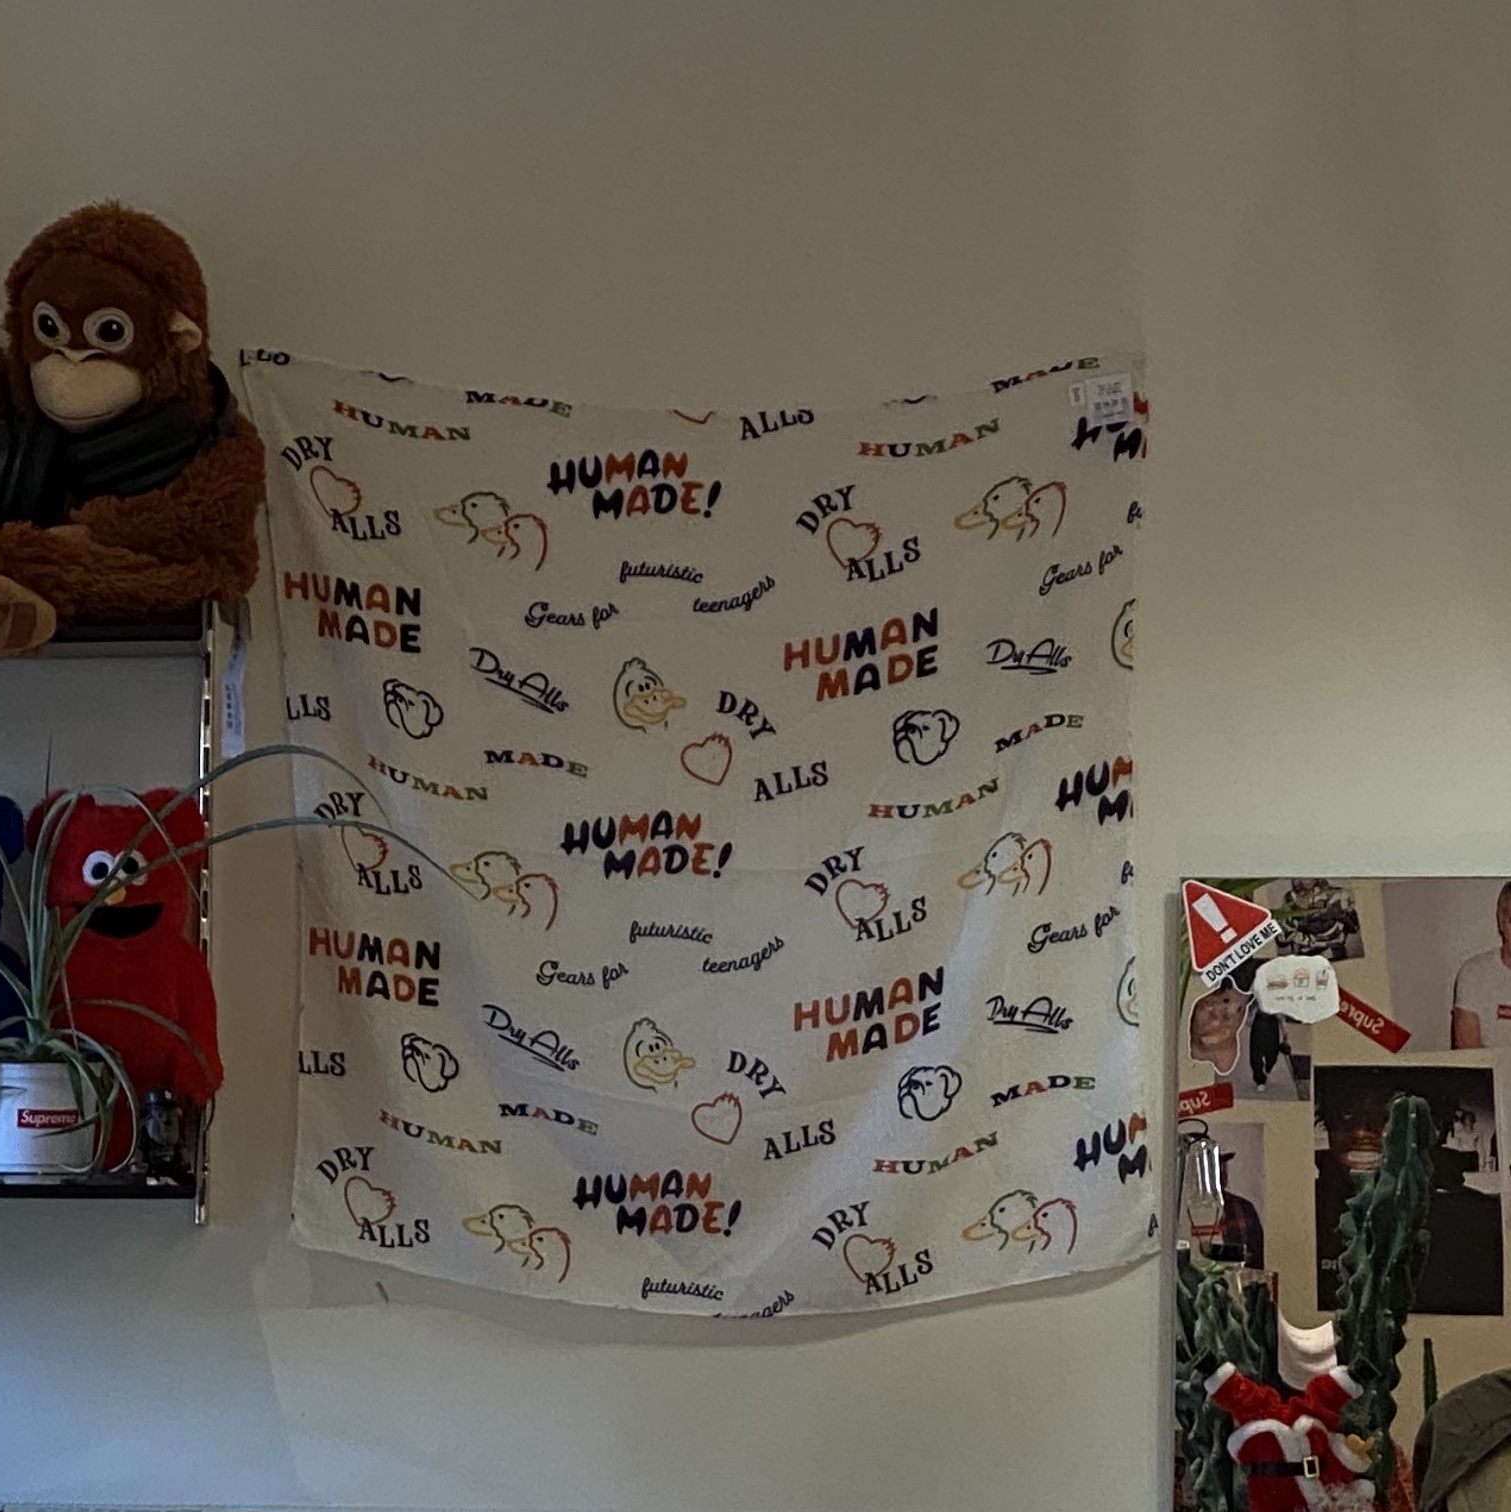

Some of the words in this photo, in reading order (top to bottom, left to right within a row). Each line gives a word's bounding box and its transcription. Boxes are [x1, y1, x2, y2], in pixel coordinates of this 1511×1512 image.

[332, 399, 470, 441] HUMAN
[739, 410, 816, 441] ALLS
[857, 418, 999, 458] HUMAN
[281, 435, 333, 470] DRY
[547, 449, 689, 495] HUMAN
[592, 481, 721, 519] MADE!
[796, 485, 856, 534] DRY
[331, 509, 402, 541] ALLS
[619, 561, 704, 584] futuristic
[846, 537, 921, 582] ALLS
[1039, 562, 1094, 595] Gears
[1099, 545, 1123, 576] for
[284, 571, 421, 616] HUMAN
[692, 576, 775, 614] teenagers
[317, 608, 421, 653] MADE
[525, 602, 586, 628] Gears
[592, 603, 618, 629] for
[784, 608, 938, 672] HUMAN
[816, 645, 937, 701] MADE
[717, 690, 776, 740] DRY
[995, 713, 1085, 753] MADE
[368, 754, 487, 800] HUMAN
[484, 749, 588, 778] MADE
[753, 761, 829, 803] ALLS
[868, 777, 999, 819] HUMAN
[561, 810, 702, 854] HUMAN
[357, 863, 422, 894] ALLS
[604, 842, 733, 879] MADE!
[804, 845, 865, 897] DRY
[630, 921, 713, 944] futuristic
[855, 897, 928, 944] ALLS
[1027, 922, 1088, 954] Gears
[1094, 906, 1120, 938] for
[309, 927, 441, 970] HUMAN
[702, 936, 784, 974] teenagers
[1234, 934, 1262, 960] LOVE
[1260, 923, 1277, 939] ME
[338, 967, 439, 1006] MADE
[536, 960, 595, 988] Gears
[601, 961, 629, 989] for
[794, 966, 945, 1032] HUMAN
[827, 1003, 941, 1063] MADE
[728, 1050, 786, 1099] DRY
[990, 1076, 1096, 1108] MADE
[20, 1111, 77, 1126] Supreme
[377, 1109, 501, 1154] HUMAN
[499, 1104, 599, 1136] MADE
[764, 1120, 836, 1161] ALLS
[873, 1132, 998, 1176] HUMAN
[316, 1146, 375, 1184] DRY
[572, 1169, 712, 1210] HUMAN
[359, 1217, 430, 1249] ALLS
[616, 1201, 742, 1237] MADE!
[813, 1200, 871, 1250] DRY
[642, 1277, 723, 1302] futuristic
[864, 1249, 935, 1296] ALLS
